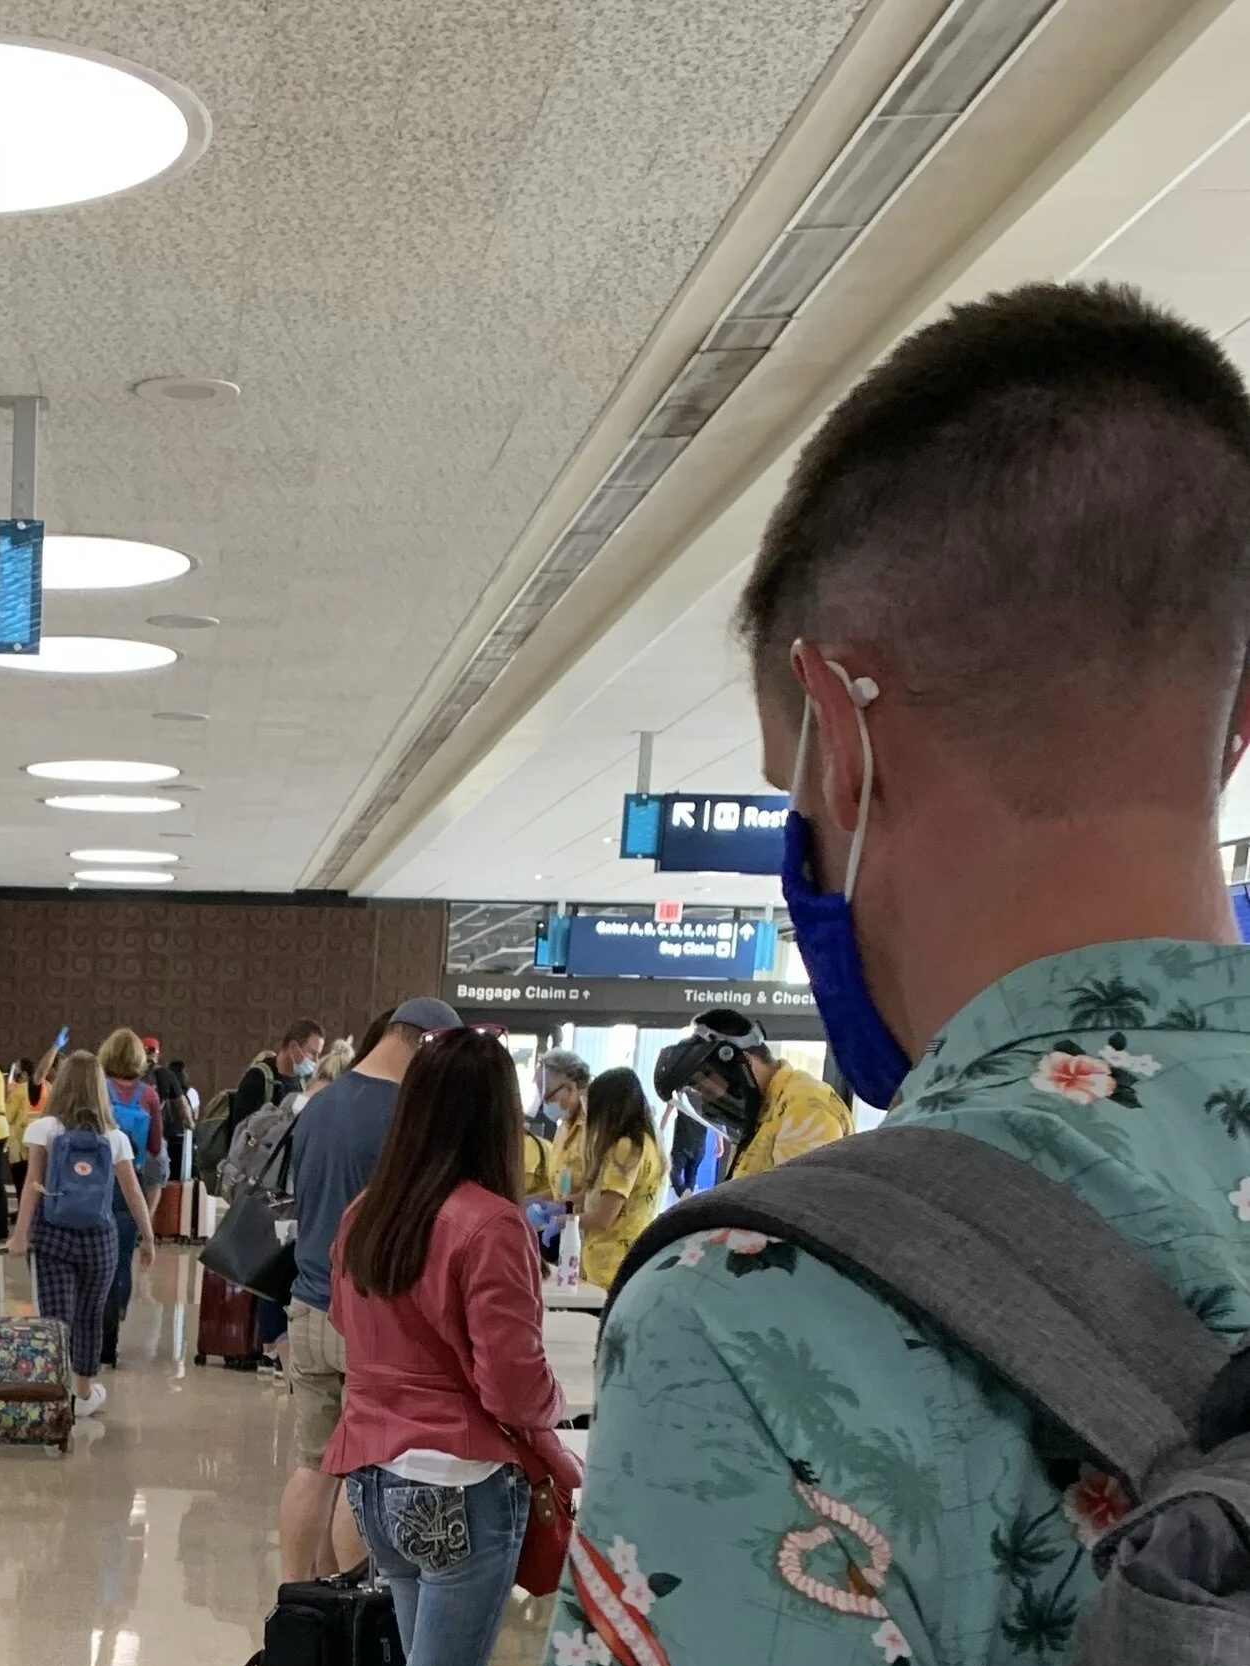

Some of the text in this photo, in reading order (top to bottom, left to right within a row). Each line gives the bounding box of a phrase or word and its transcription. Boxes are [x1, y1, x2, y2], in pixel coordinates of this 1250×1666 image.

[457, 984, 566, 1001] Baggage Claim
[684, 989, 751, 1006] Ticketing
[757, 991, 767, 1004] &
